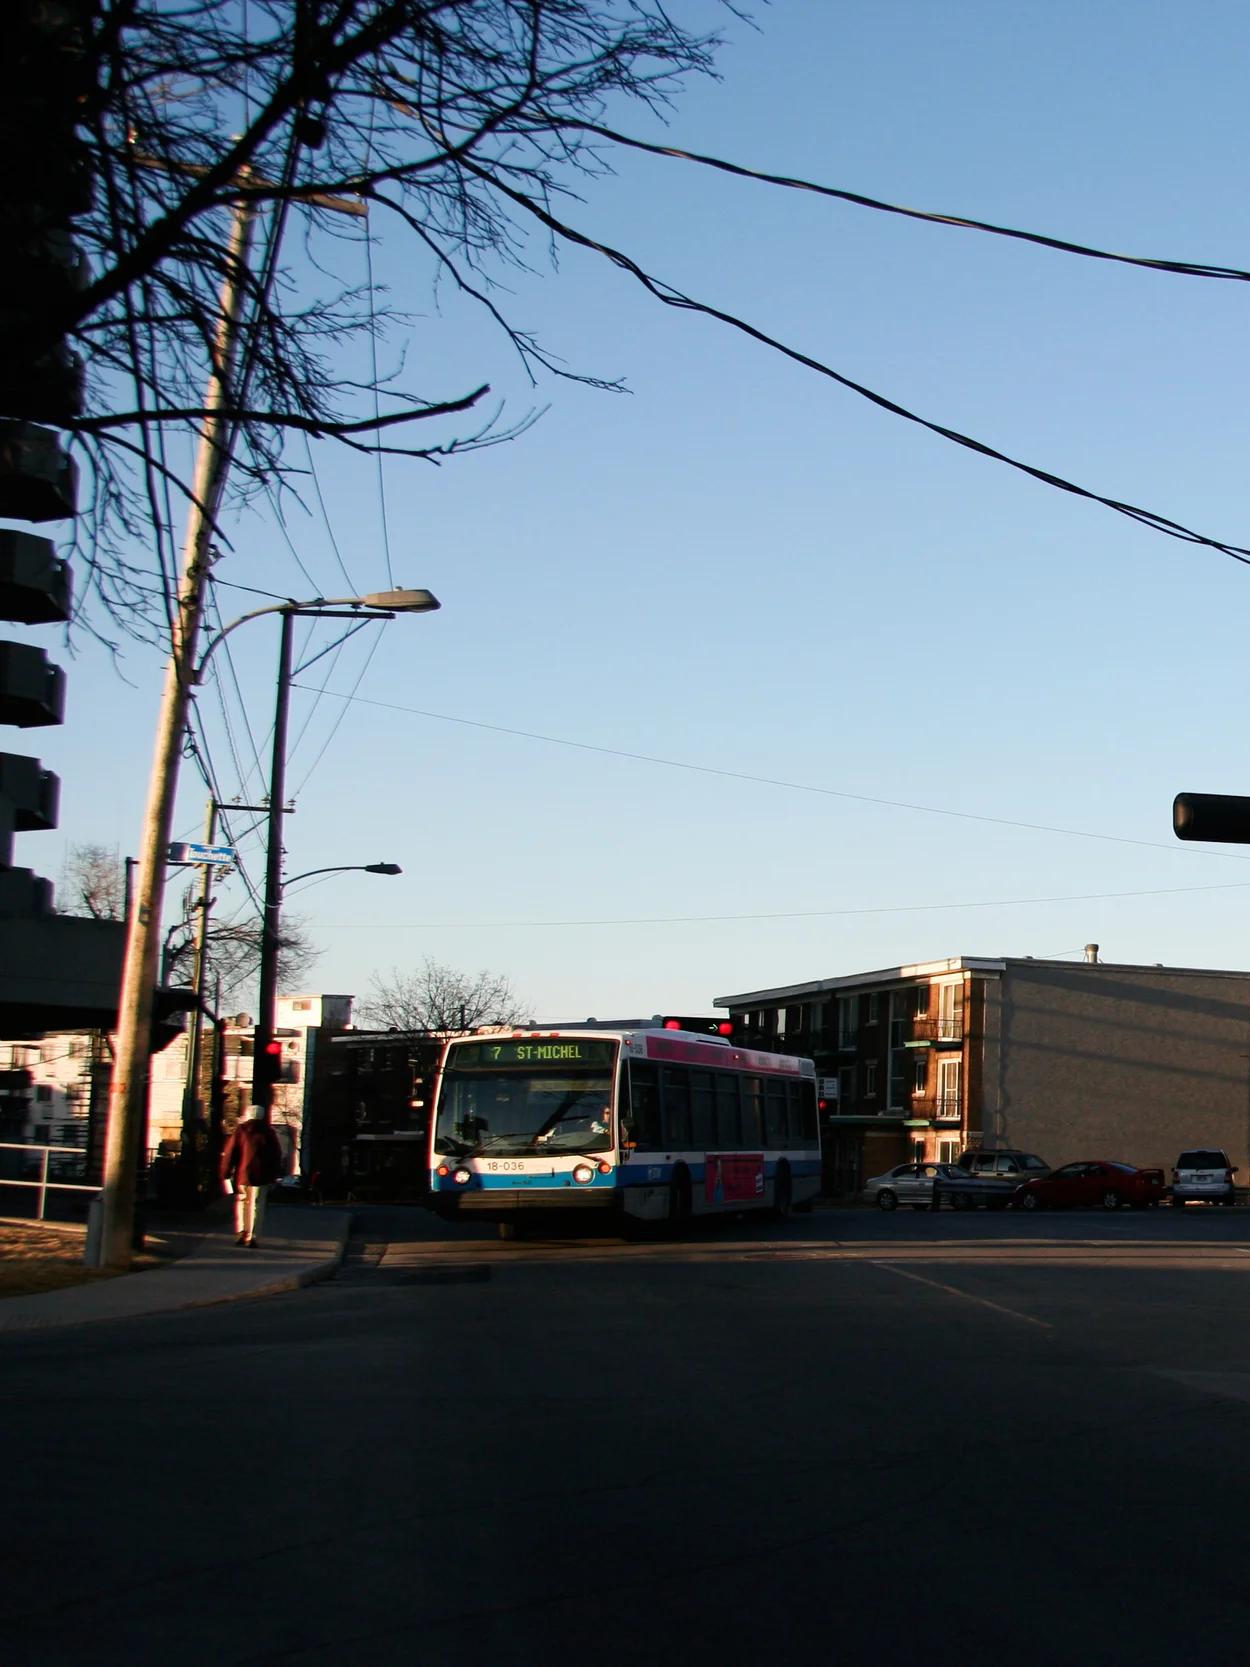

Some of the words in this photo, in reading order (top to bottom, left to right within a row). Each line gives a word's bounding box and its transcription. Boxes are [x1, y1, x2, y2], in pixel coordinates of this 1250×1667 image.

[490, 1046, 502, 1060] 7
[516, 1045, 582, 1060] ST-MICHEL
[487, 1161, 525, 1171] 18-036
